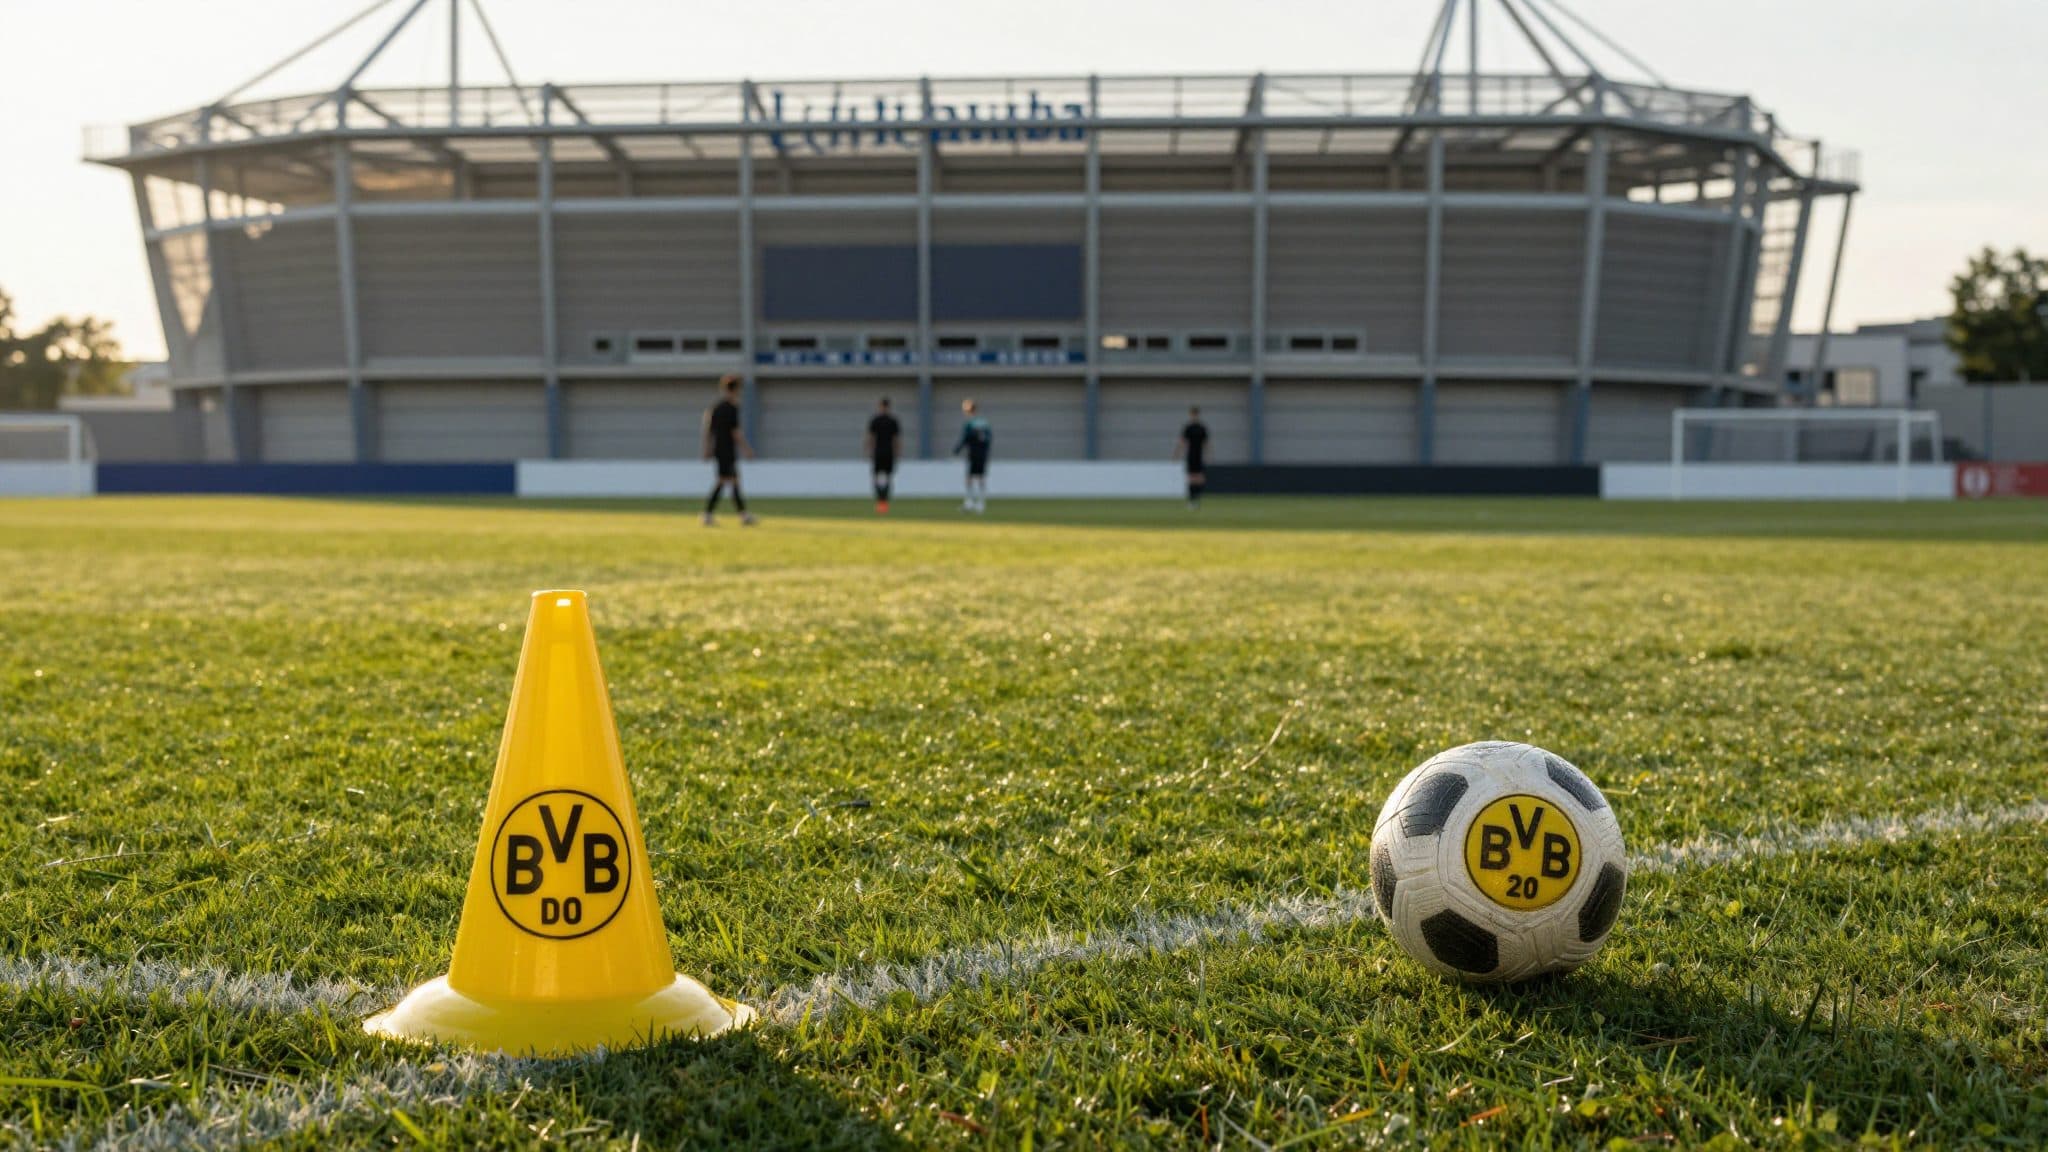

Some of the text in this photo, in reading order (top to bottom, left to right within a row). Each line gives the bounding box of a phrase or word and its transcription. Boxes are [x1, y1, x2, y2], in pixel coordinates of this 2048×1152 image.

[506, 804, 620, 895] BVB
[1480, 804, 1571, 879] BVB
[541, 897, 582, 925] DO
[1506, 874, 1539, 899] 20
